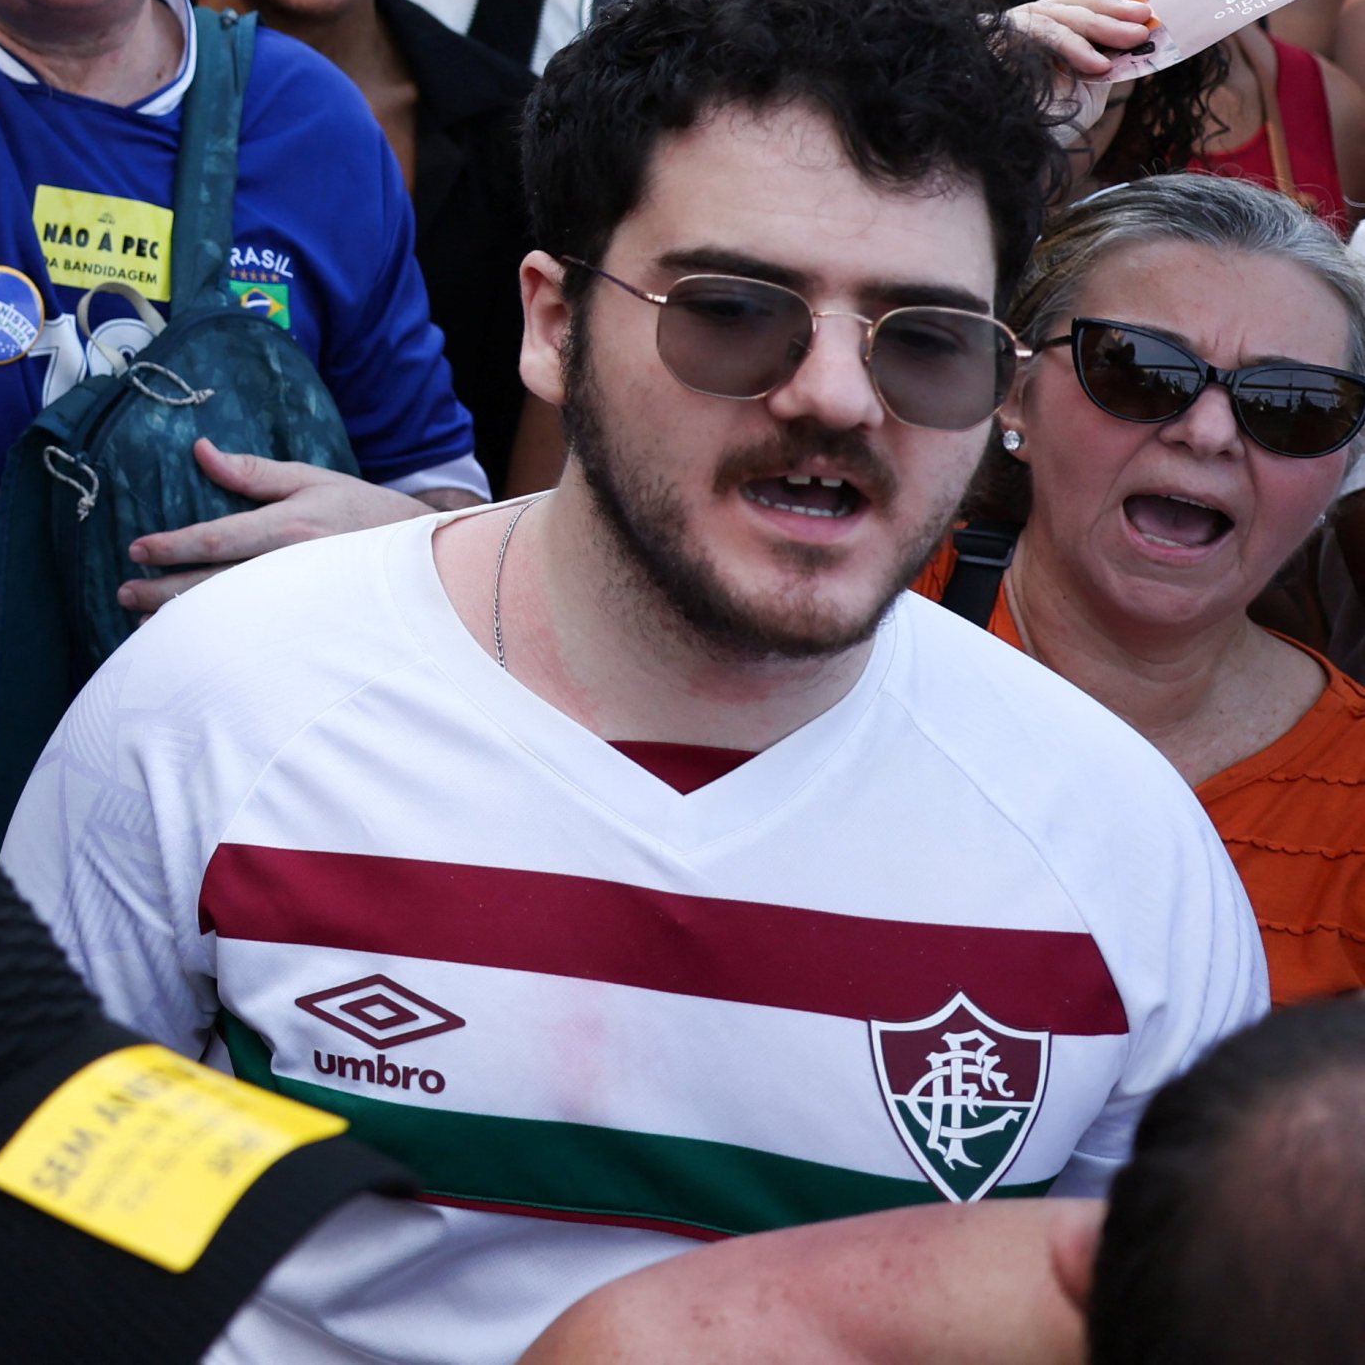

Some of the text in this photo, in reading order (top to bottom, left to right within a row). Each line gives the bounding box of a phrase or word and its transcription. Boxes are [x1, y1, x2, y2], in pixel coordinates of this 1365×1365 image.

[122, 235, 159, 260] PEC
[64, 258, 157, 284] BANDIDAGEM
[230, 246, 294, 279] RASIL
[313, 1049, 447, 1095] umbro
